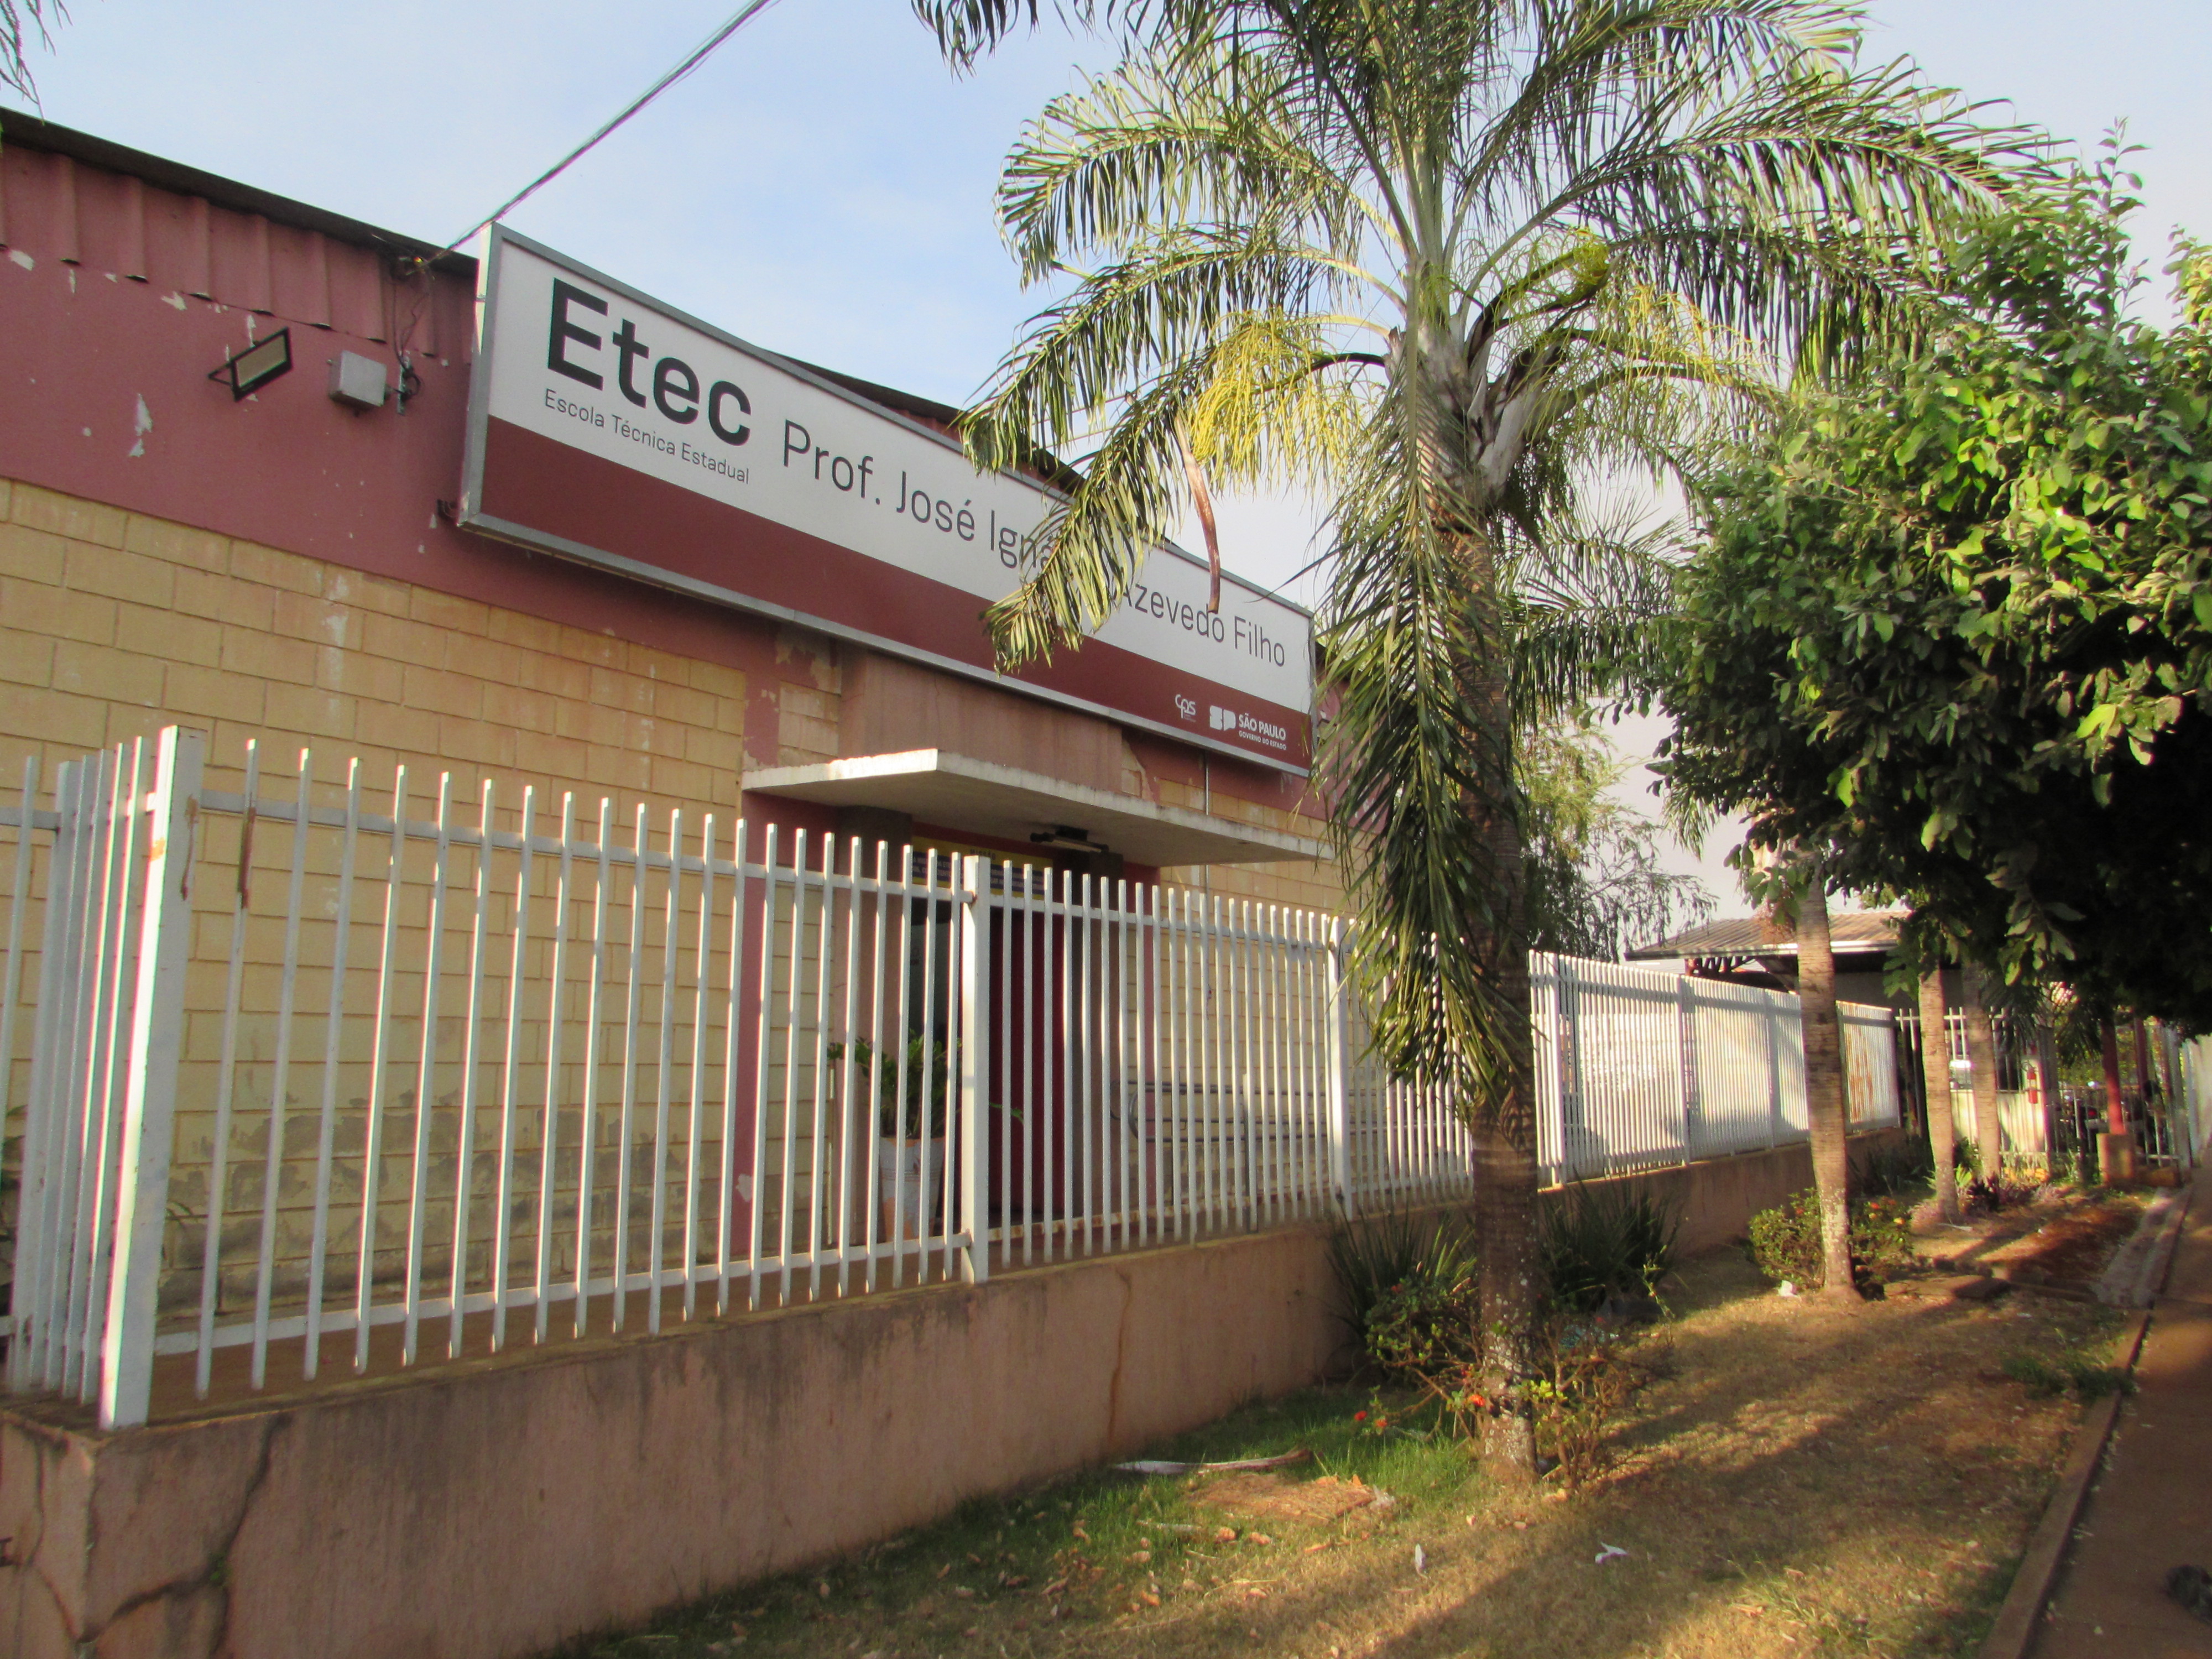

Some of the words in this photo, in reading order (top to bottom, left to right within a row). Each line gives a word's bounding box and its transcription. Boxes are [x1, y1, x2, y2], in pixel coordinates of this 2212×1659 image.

[547, 277, 751, 446] Etec
[545, 388, 605, 429] Escola
[612, 414, 676, 456] Técnica
[681, 443, 749, 484] Estadual
[783, 419, 881, 505] Prof.
[896, 471, 975, 541] José
[1234, 615, 1285, 667] Filho
[1238, 712, 1258, 733] SÃO
[1258, 721, 1286, 741] PAULO
[1238, 730, 1262, 743] GOVERNO
[1262, 737, 1269, 745] DO
[1270, 739, 1287, 751] ESTADO
